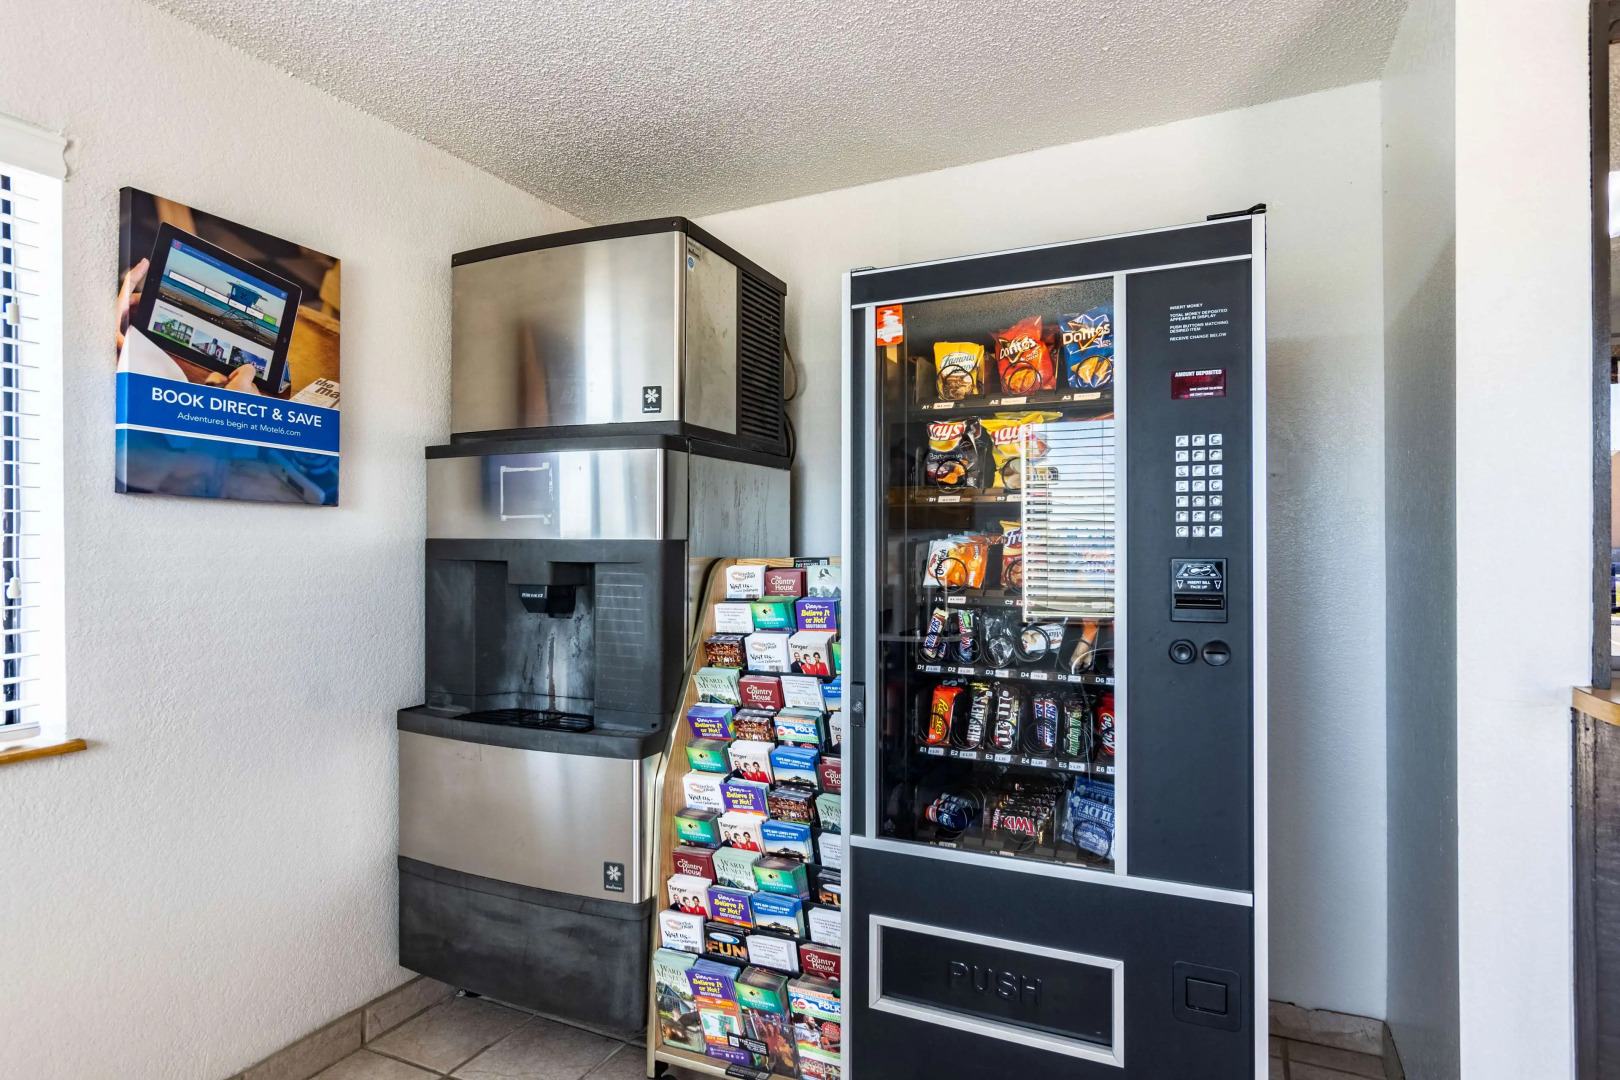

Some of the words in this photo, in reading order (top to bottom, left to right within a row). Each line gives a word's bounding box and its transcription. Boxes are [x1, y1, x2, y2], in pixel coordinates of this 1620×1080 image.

[1062, 324, 1110, 345] Doritos
[999, 336, 1037, 360] Doritos
[942, 354, 976, 366] Famous
[316, 378, 334, 389] the
[151, 387, 204, 408] BOOK
[210, 397, 268, 418] DIRECT
[272, 408, 283, 421] &
[288, 410, 322, 428] SAVE
[177, 412, 224, 426] Adventures
[226, 418, 248, 430] begin
[250, 422, 258, 431] at
[260, 424, 301, 437] Motel6.com
[770, 578, 795, 586] Country
[698, 682, 730, 690] MUSEUM
[746, 687, 772, 697] Country
[752, 693, 771, 701] House
[795, 726, 815, 734] FOLK
[730, 752, 747, 760] Tanger
[726, 791, 747, 799] Believe
[1082, 804, 1101, 818] ACT
[1101, 810, 1112, 822] II
[719, 821, 738, 829] Tanger
[1002, 816, 1035, 836] TWIX
[677, 861, 703, 872] Country
[720, 858, 745, 869] WARD
[682, 868, 701, 876] House
[717, 864, 750, 876] MUSEUM
[668, 884, 687, 893] Tanger
[714, 899, 736, 908] Believe
[738, 902, 744, 910] It
[819, 892, 841, 906] FU
[728, 907, 741, 916] Not!
[706, 940, 748, 958] FUN
[806, 954, 836, 967] Country
[660, 964, 682, 976] WARD
[812, 961, 834, 972] House
[657, 969, 687, 983] MUSEUM
[693, 978, 715, 987] Believe
[948, 960, 1044, 1006] PUSH
[818, 1002, 841, 1012] FOLK
